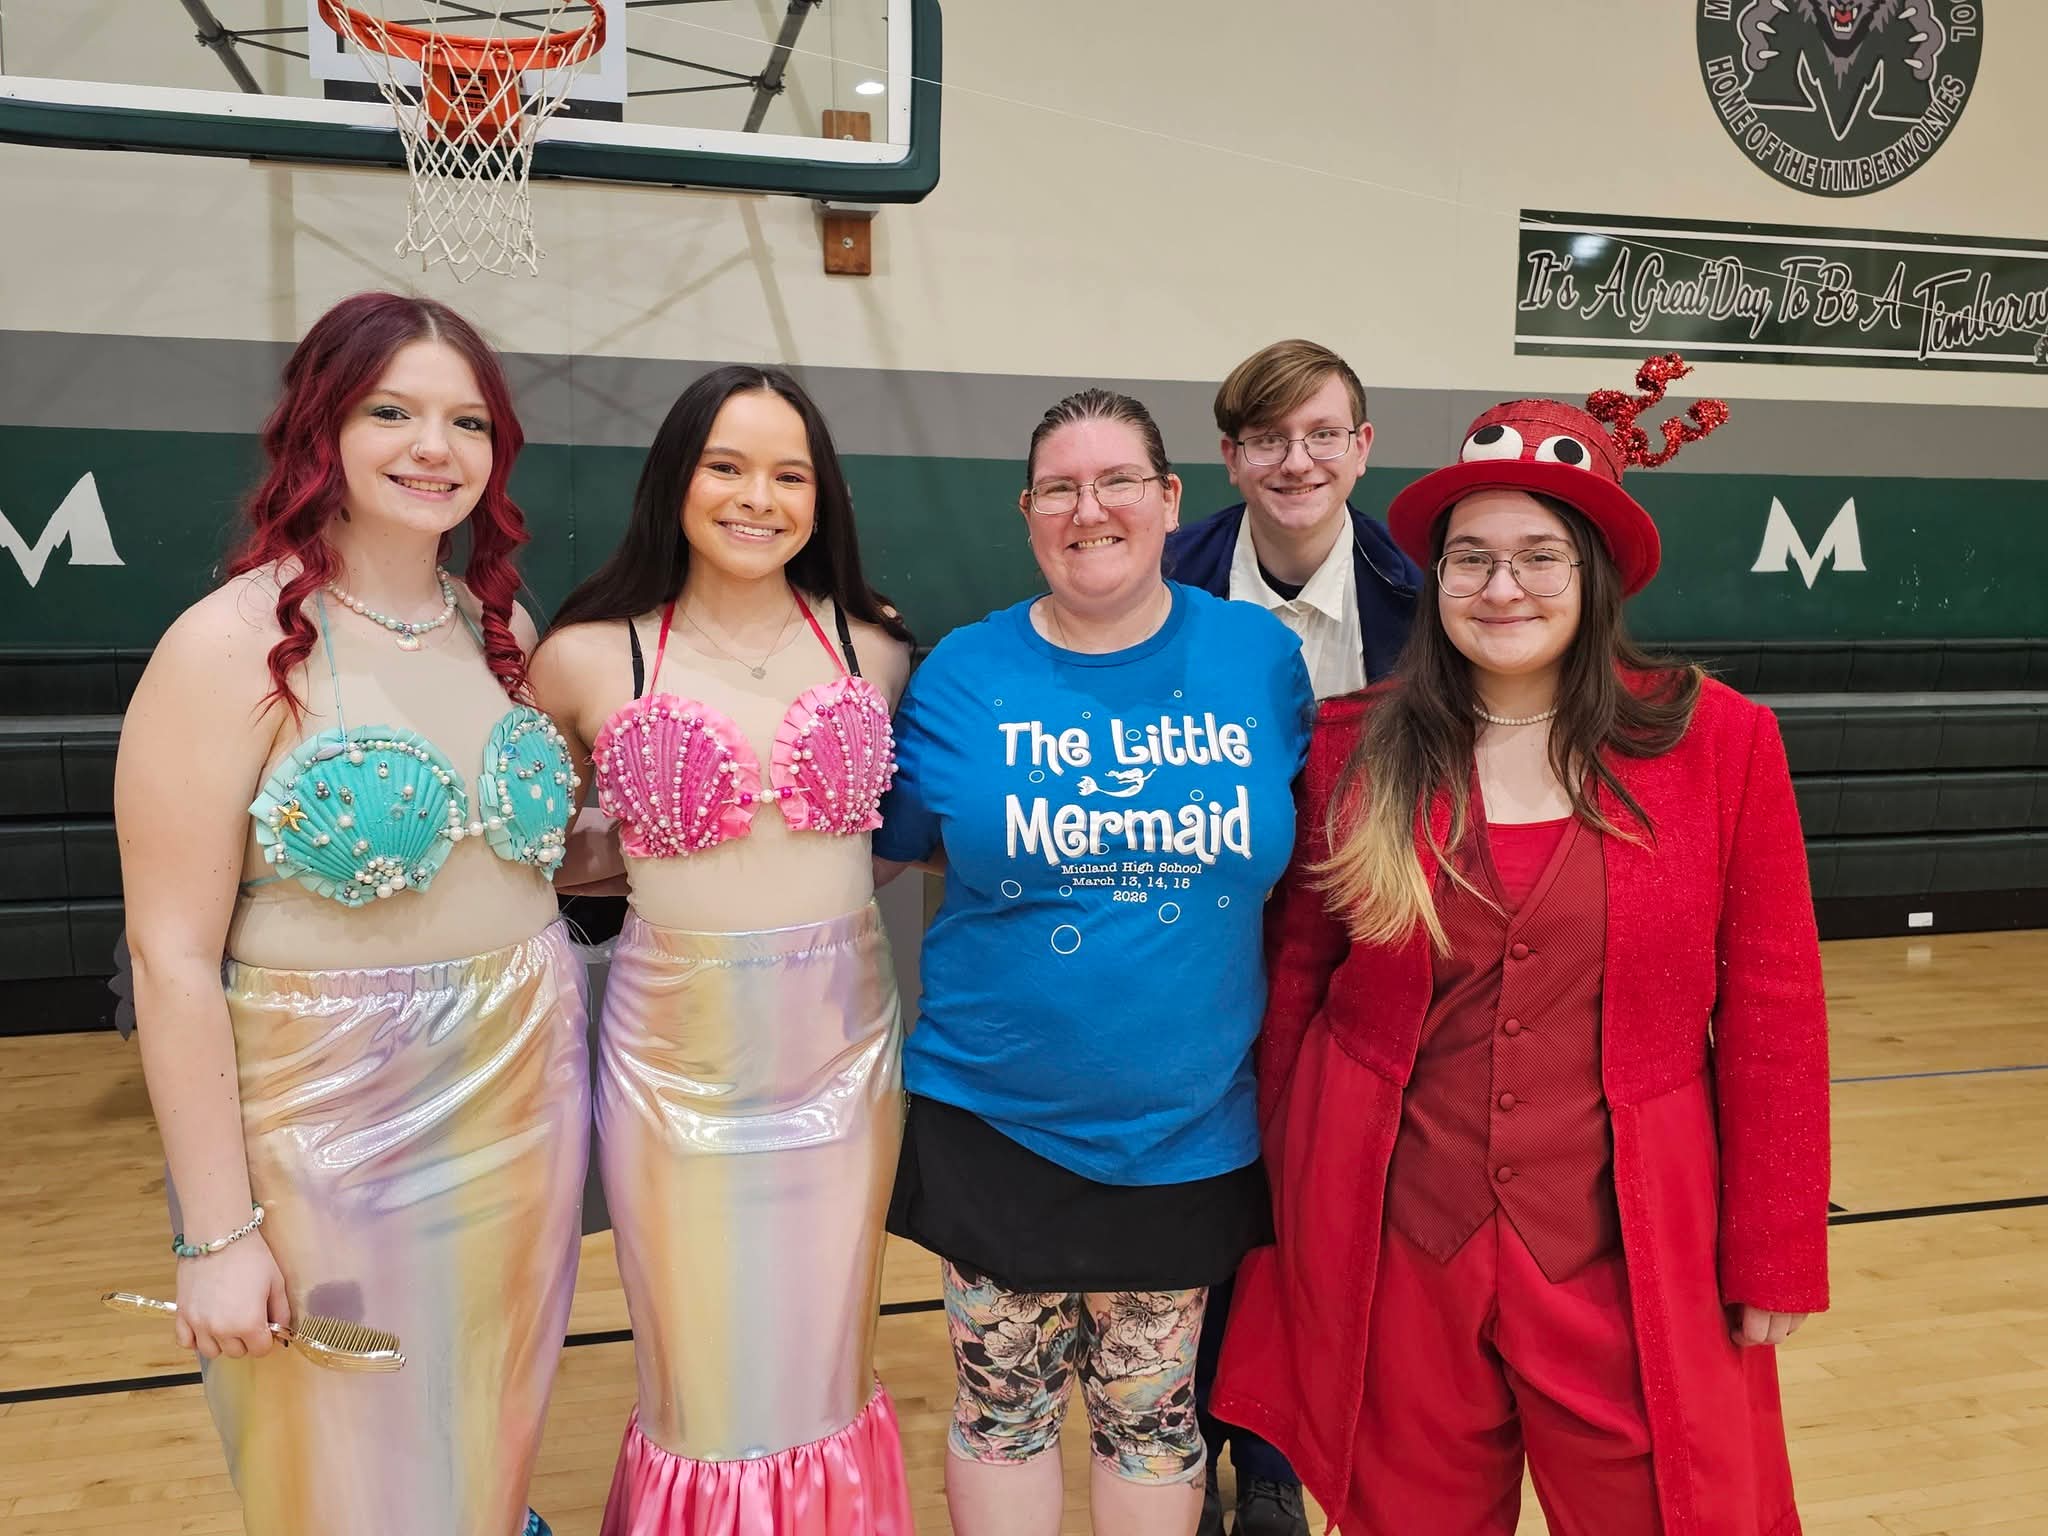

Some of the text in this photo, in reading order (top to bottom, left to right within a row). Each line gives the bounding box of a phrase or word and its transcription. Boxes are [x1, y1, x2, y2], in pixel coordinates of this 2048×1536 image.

[1706, 55, 1966, 191] HOME OF THE TIMBERWOLVES
[1518, 250, 1579, 311] It's
[1580, 246, 1630, 320] A
[1630, 252, 1718, 333] Great
[1708, 256, 1772, 339] Day
[1777, 256, 1826, 323] To
[1813, 262, 1858, 326] Be
[1859, 261, 1905, 332] A
[1750, 496, 1867, 590] M
[999, 712, 1252, 776] The Little
[1006, 785, 1253, 865] Mermaid
[1061, 861, 1202, 875] Midland High School
[1072, 876, 1190, 890] March 13, 14, 15
[1112, 890, 1148, 903] 2026
